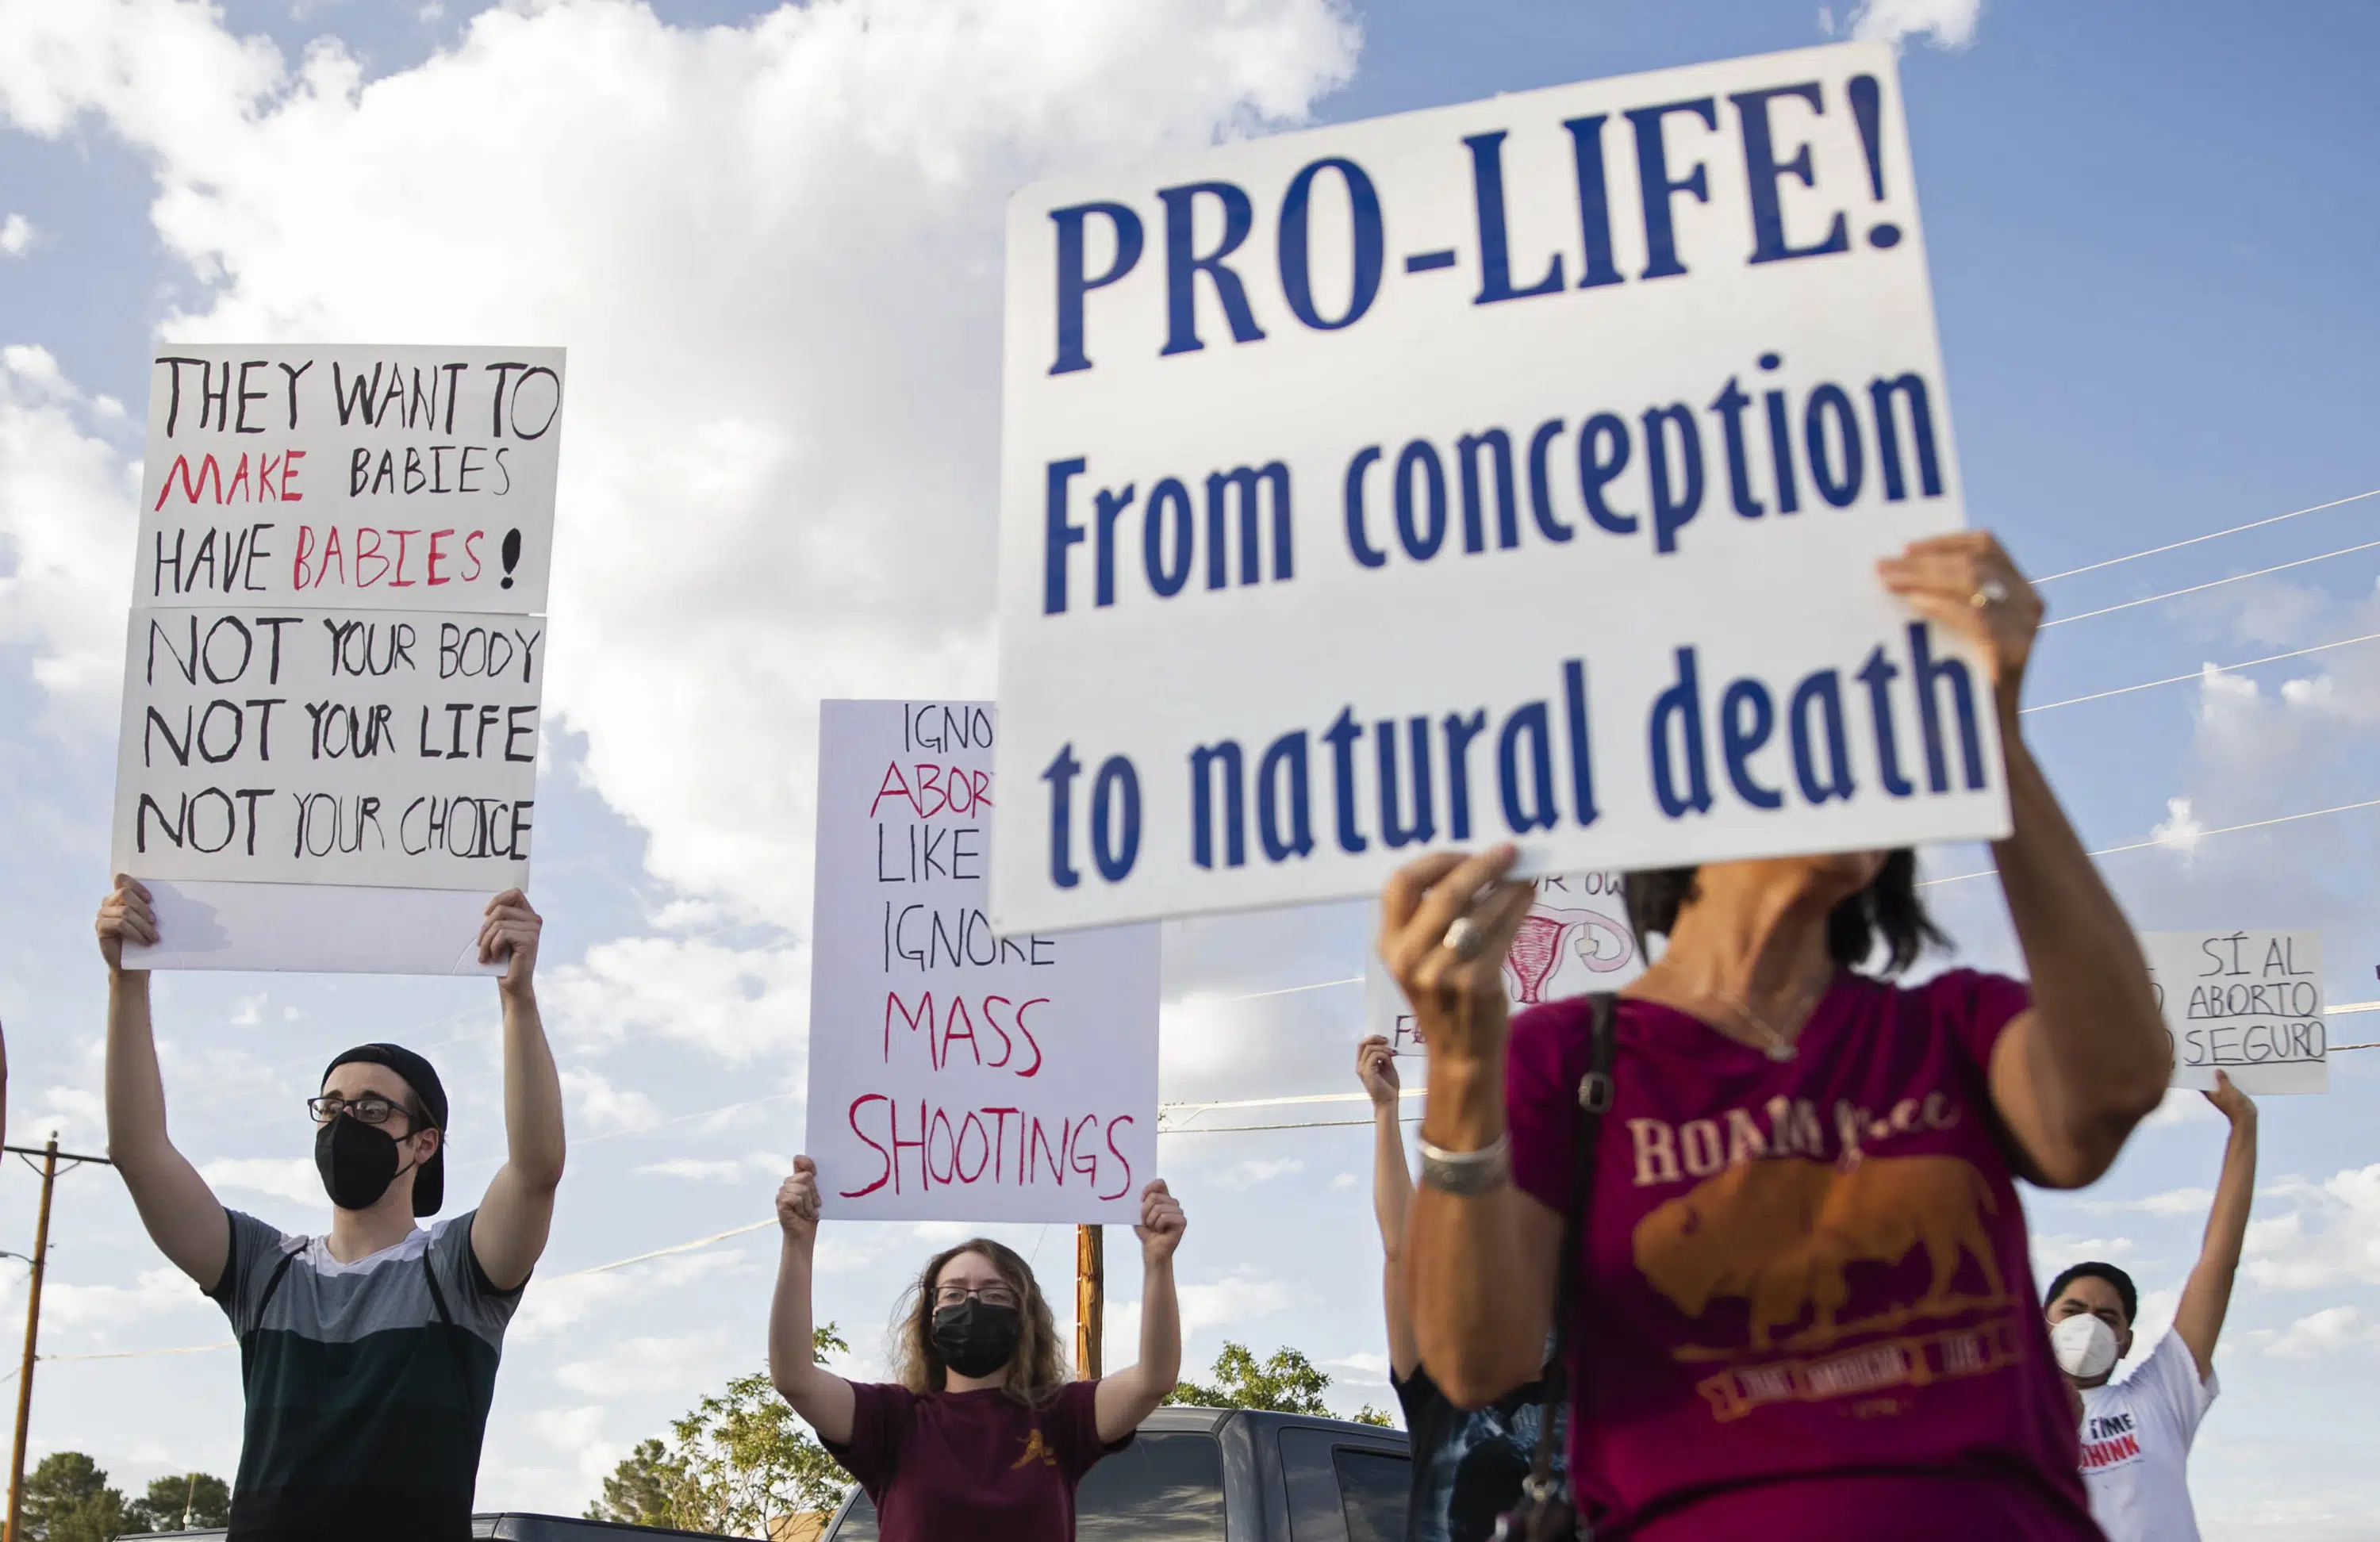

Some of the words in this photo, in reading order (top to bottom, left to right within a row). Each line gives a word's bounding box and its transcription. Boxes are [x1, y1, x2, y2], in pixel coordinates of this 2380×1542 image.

[1047, 73, 1903, 378] PRO-LIFE!
[155, 357, 313, 438] THEY
[333, 362, 468, 435] WANT
[486, 362, 559, 440] TO
[155, 450, 306, 512] MAKE
[350, 446, 509, 497] BABIES
[1044, 457, 1294, 616] From
[1344, 352, 1945, 567] conception
[155, 524, 274, 596] HAVE
[148, 615, 303, 686] NOT
[323, 618, 415, 676] YOUR
[440, 623, 540, 683] BODY
[144, 699, 286, 768] NOT
[305, 700, 395, 760] YOUR
[420, 704, 537, 762] LIFE
[1042, 743, 1142, 890] to
[1188, 658, 1603, 865] natural
[1649, 620, 1987, 820] death
[137, 787, 275, 856] NOT
[293, 793, 384, 858] YOUR
[401, 796, 534, 861] CHOICE
[870, 761, 996, 819] ABOR
[879, 823, 980, 883] LIKE
[885, 901, 1054, 972] IGNORE
[2200, 931, 2250, 976] SÍ
[2264, 938, 2313, 976] AL
[885, 992, 1050, 1077] MASS
[2188, 982, 2317, 1016] ABORTO
[2184, 1022, 2325, 1064] SEGURO
[839, 1094, 1133, 1201] SHOOTINGS
[1628, 1095, 1826, 1187] ROAM
